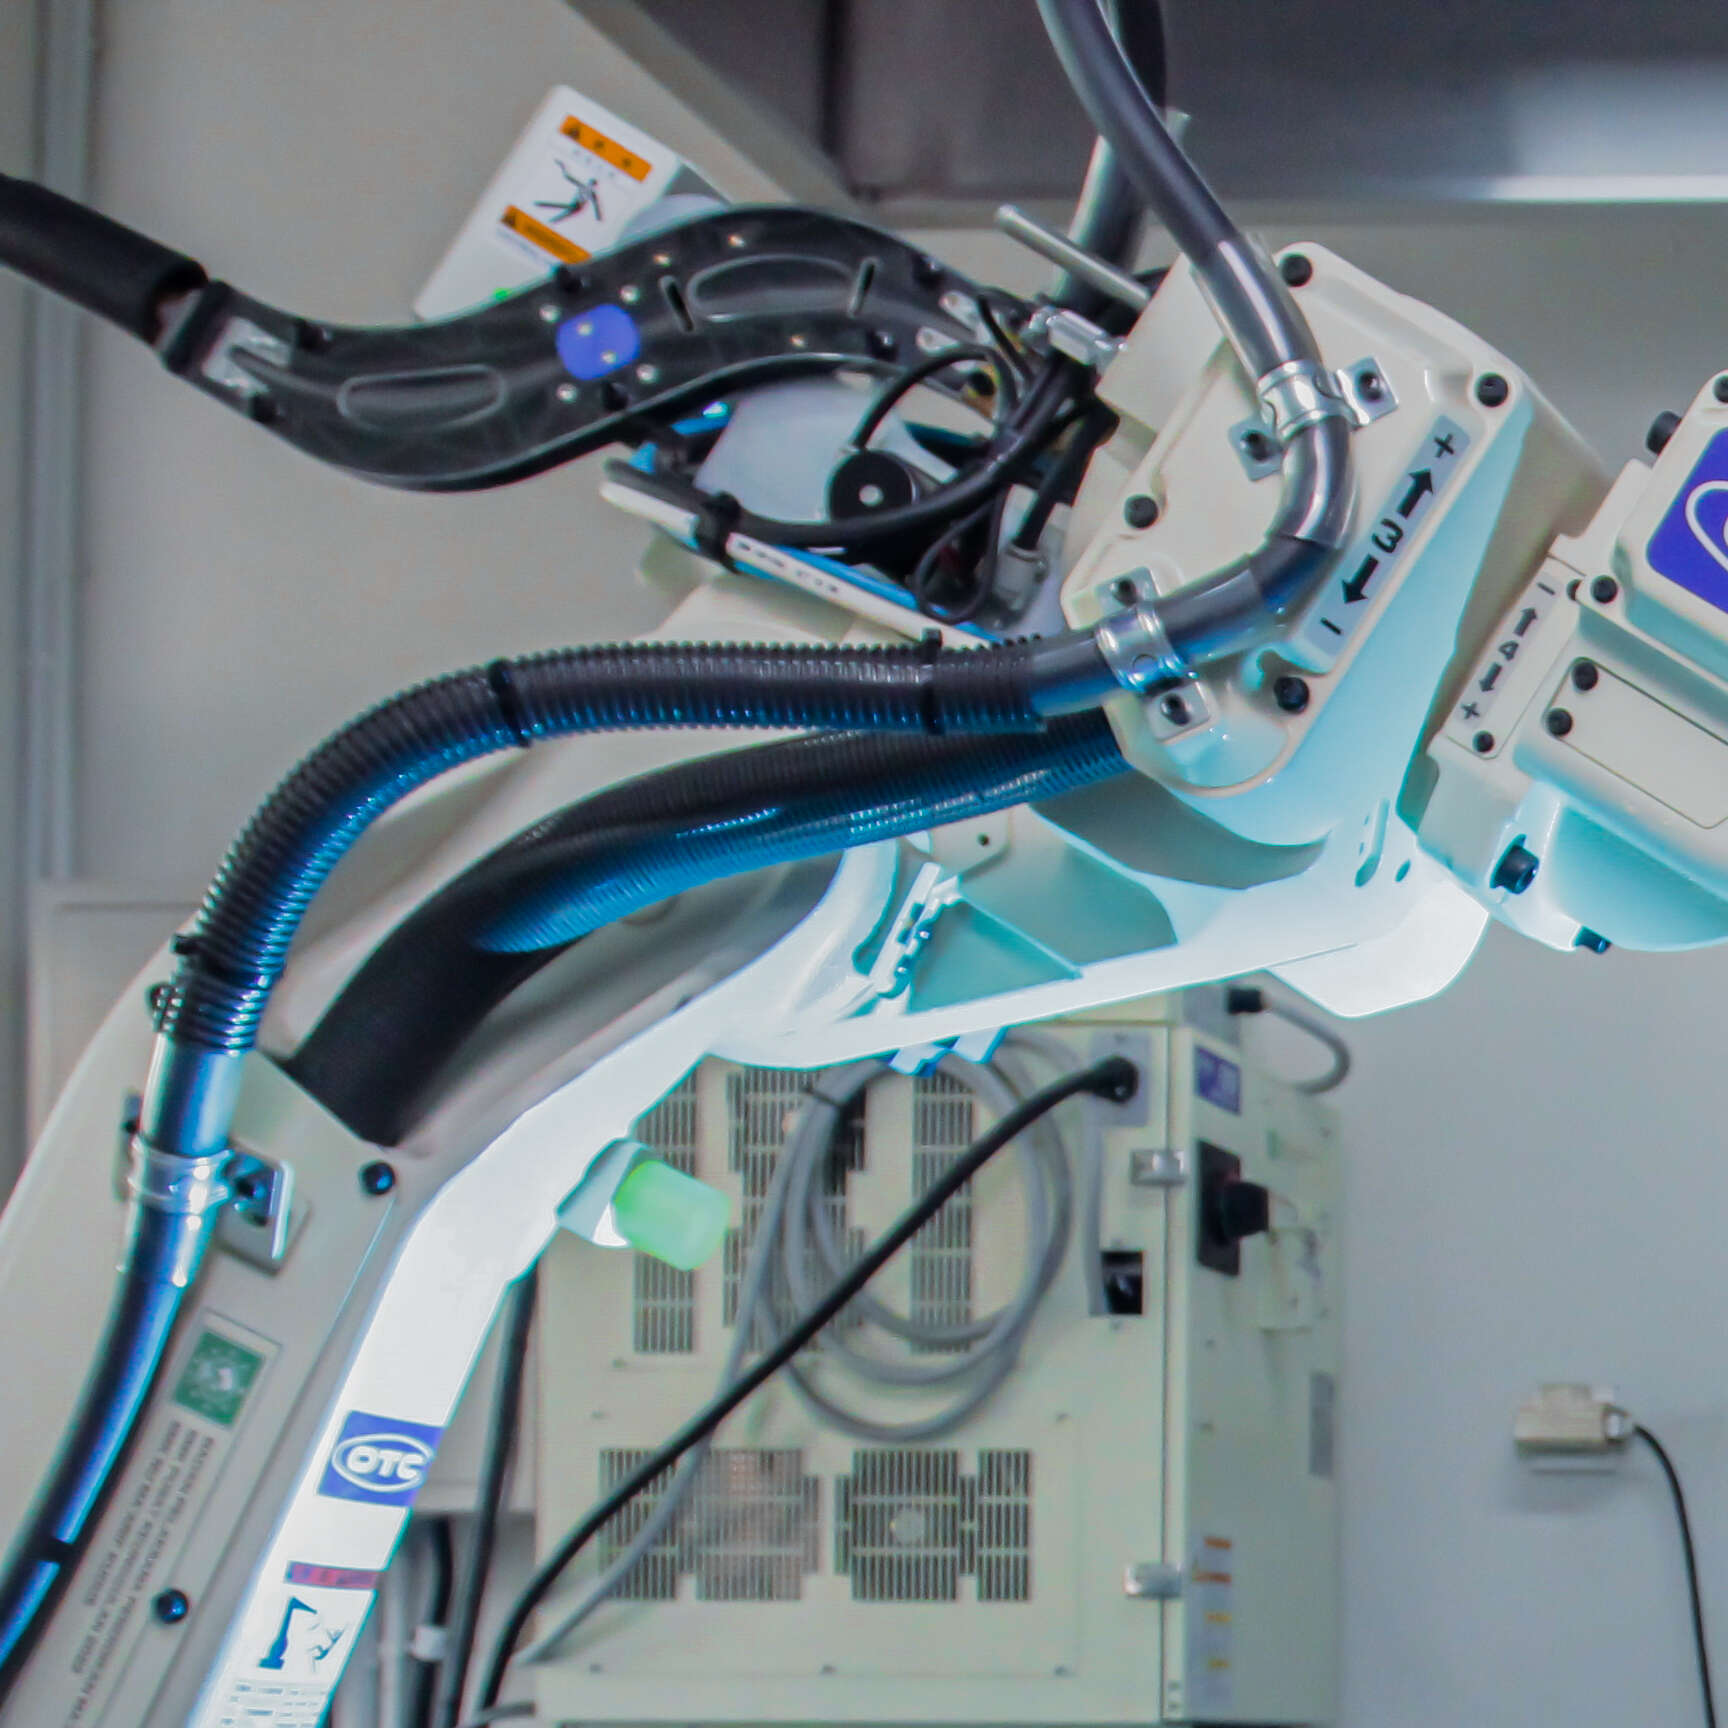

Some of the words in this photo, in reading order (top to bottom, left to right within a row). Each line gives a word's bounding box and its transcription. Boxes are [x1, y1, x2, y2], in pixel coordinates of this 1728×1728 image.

[1372, 519, 1404, 553] 3
[1498, 640, 1519, 661] 4
[347, 1447, 425, 1481] OTC
